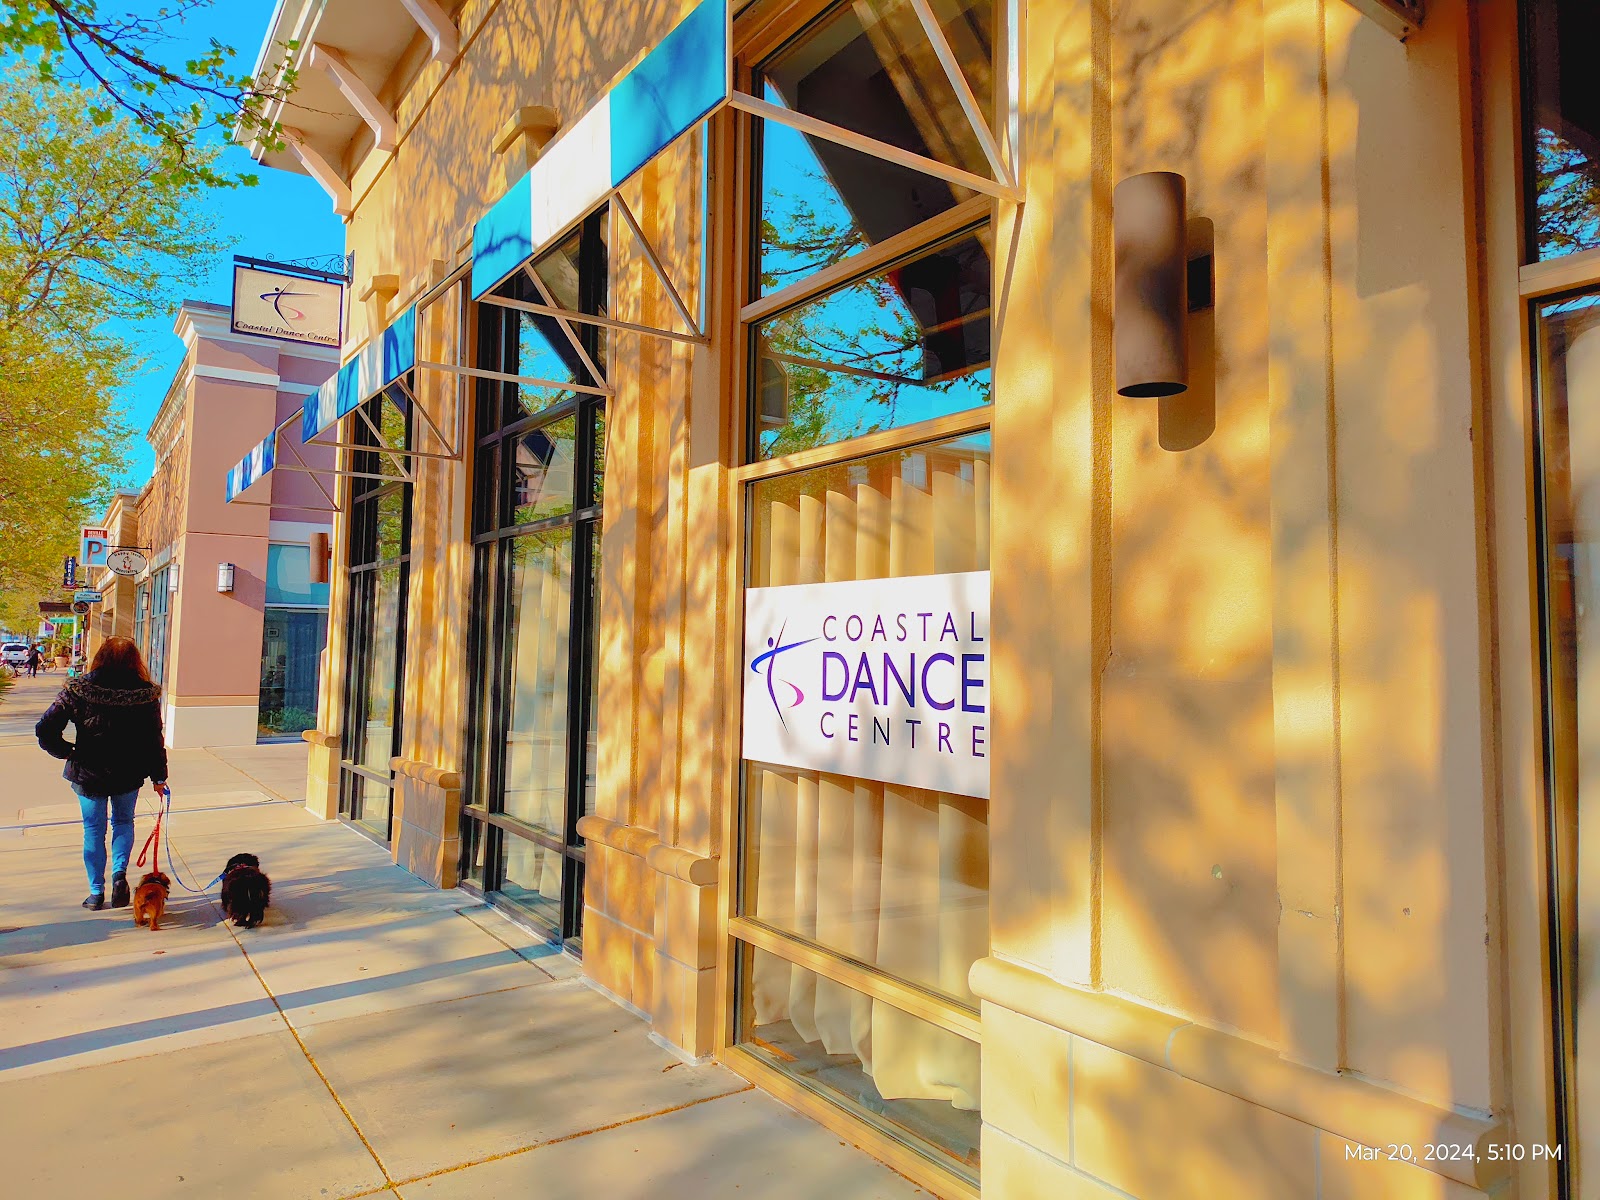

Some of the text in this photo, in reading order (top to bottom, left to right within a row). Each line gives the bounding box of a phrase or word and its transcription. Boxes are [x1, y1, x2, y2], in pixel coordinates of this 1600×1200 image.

[235, 320, 337, 343] Coastal Dance Centre
[87, 540, 103, 564] P
[822, 611, 984, 642] COASTAL
[821, 651, 986, 714] DANCE
[820, 711, 986, 758] CENTRE
